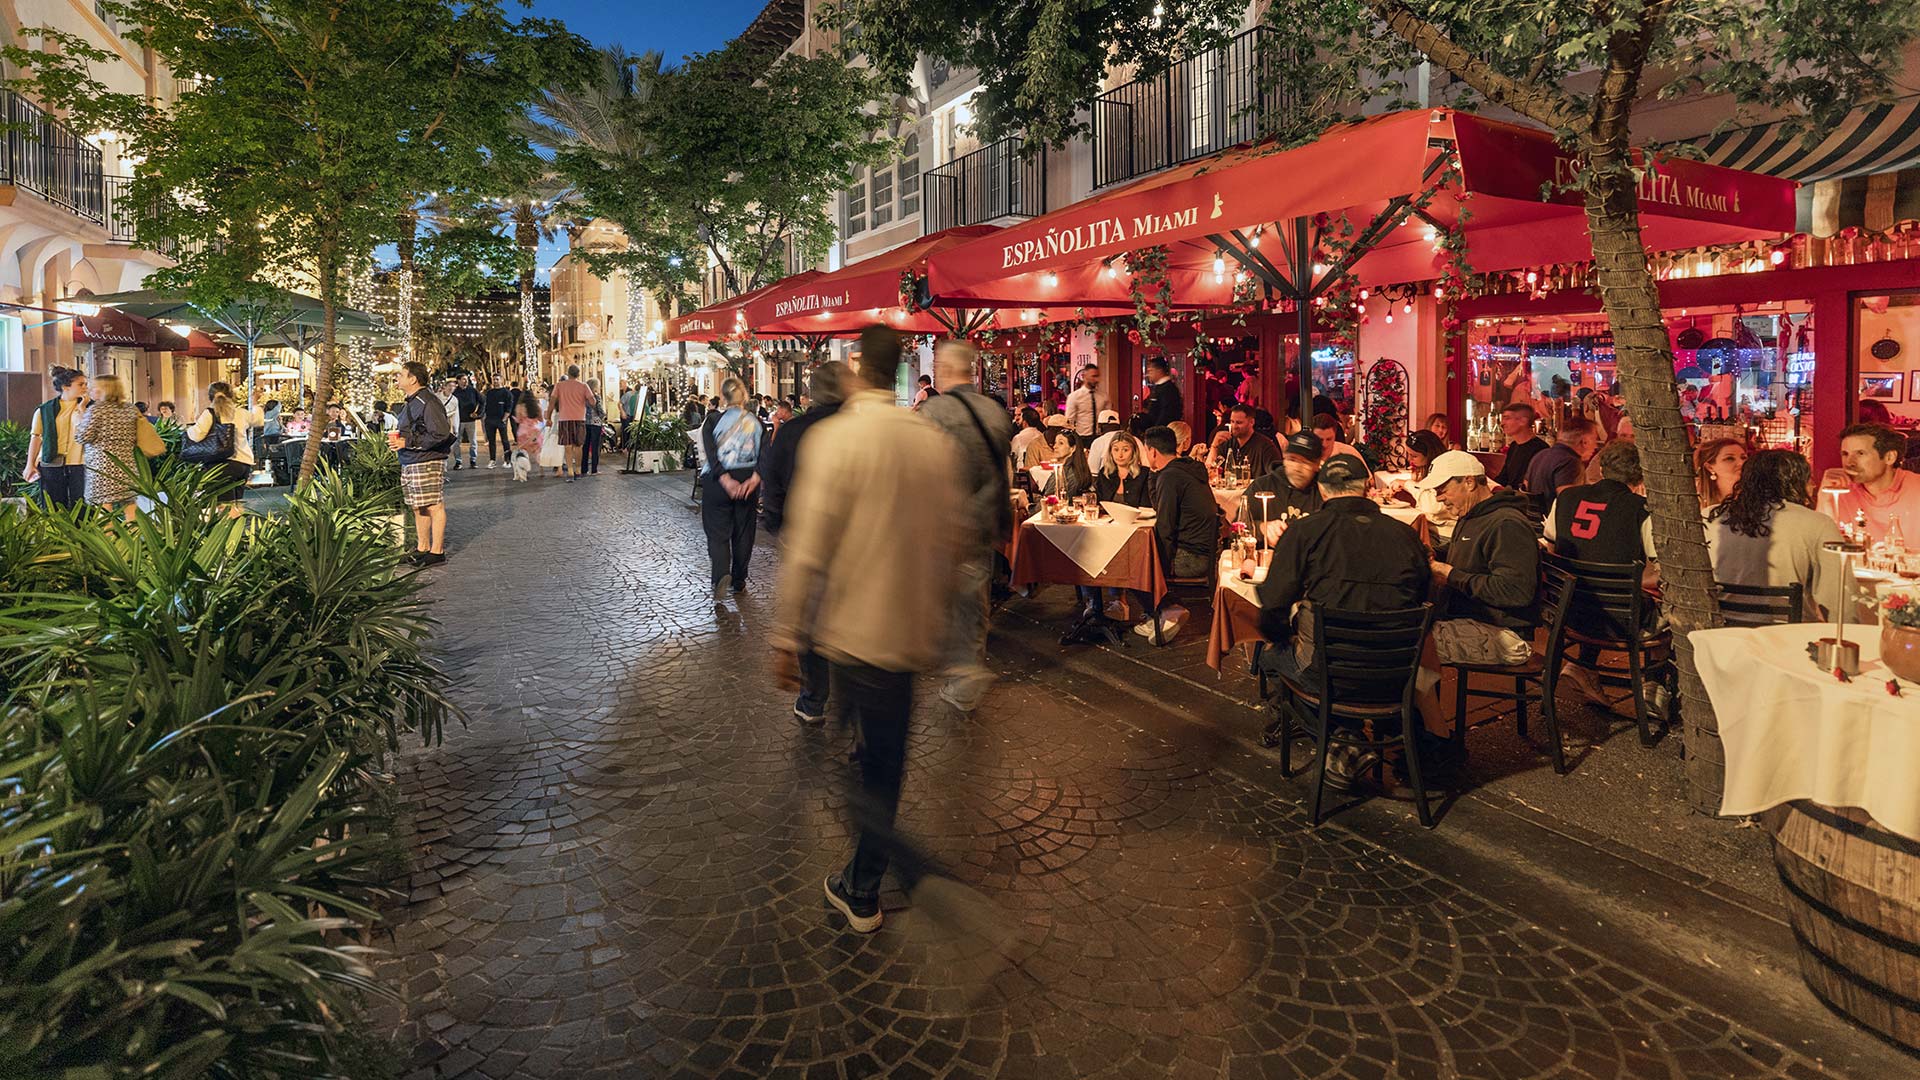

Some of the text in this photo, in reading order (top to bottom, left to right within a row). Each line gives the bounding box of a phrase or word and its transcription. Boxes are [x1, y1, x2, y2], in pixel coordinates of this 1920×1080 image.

[1555, 157, 1682, 206] ESLITA
[1002, 207, 1199, 269] ESPAÑOLITA MIAMI
[776, 294, 820, 317] ESPAÑOLITA
[1571, 500, 1608, 539] 5
